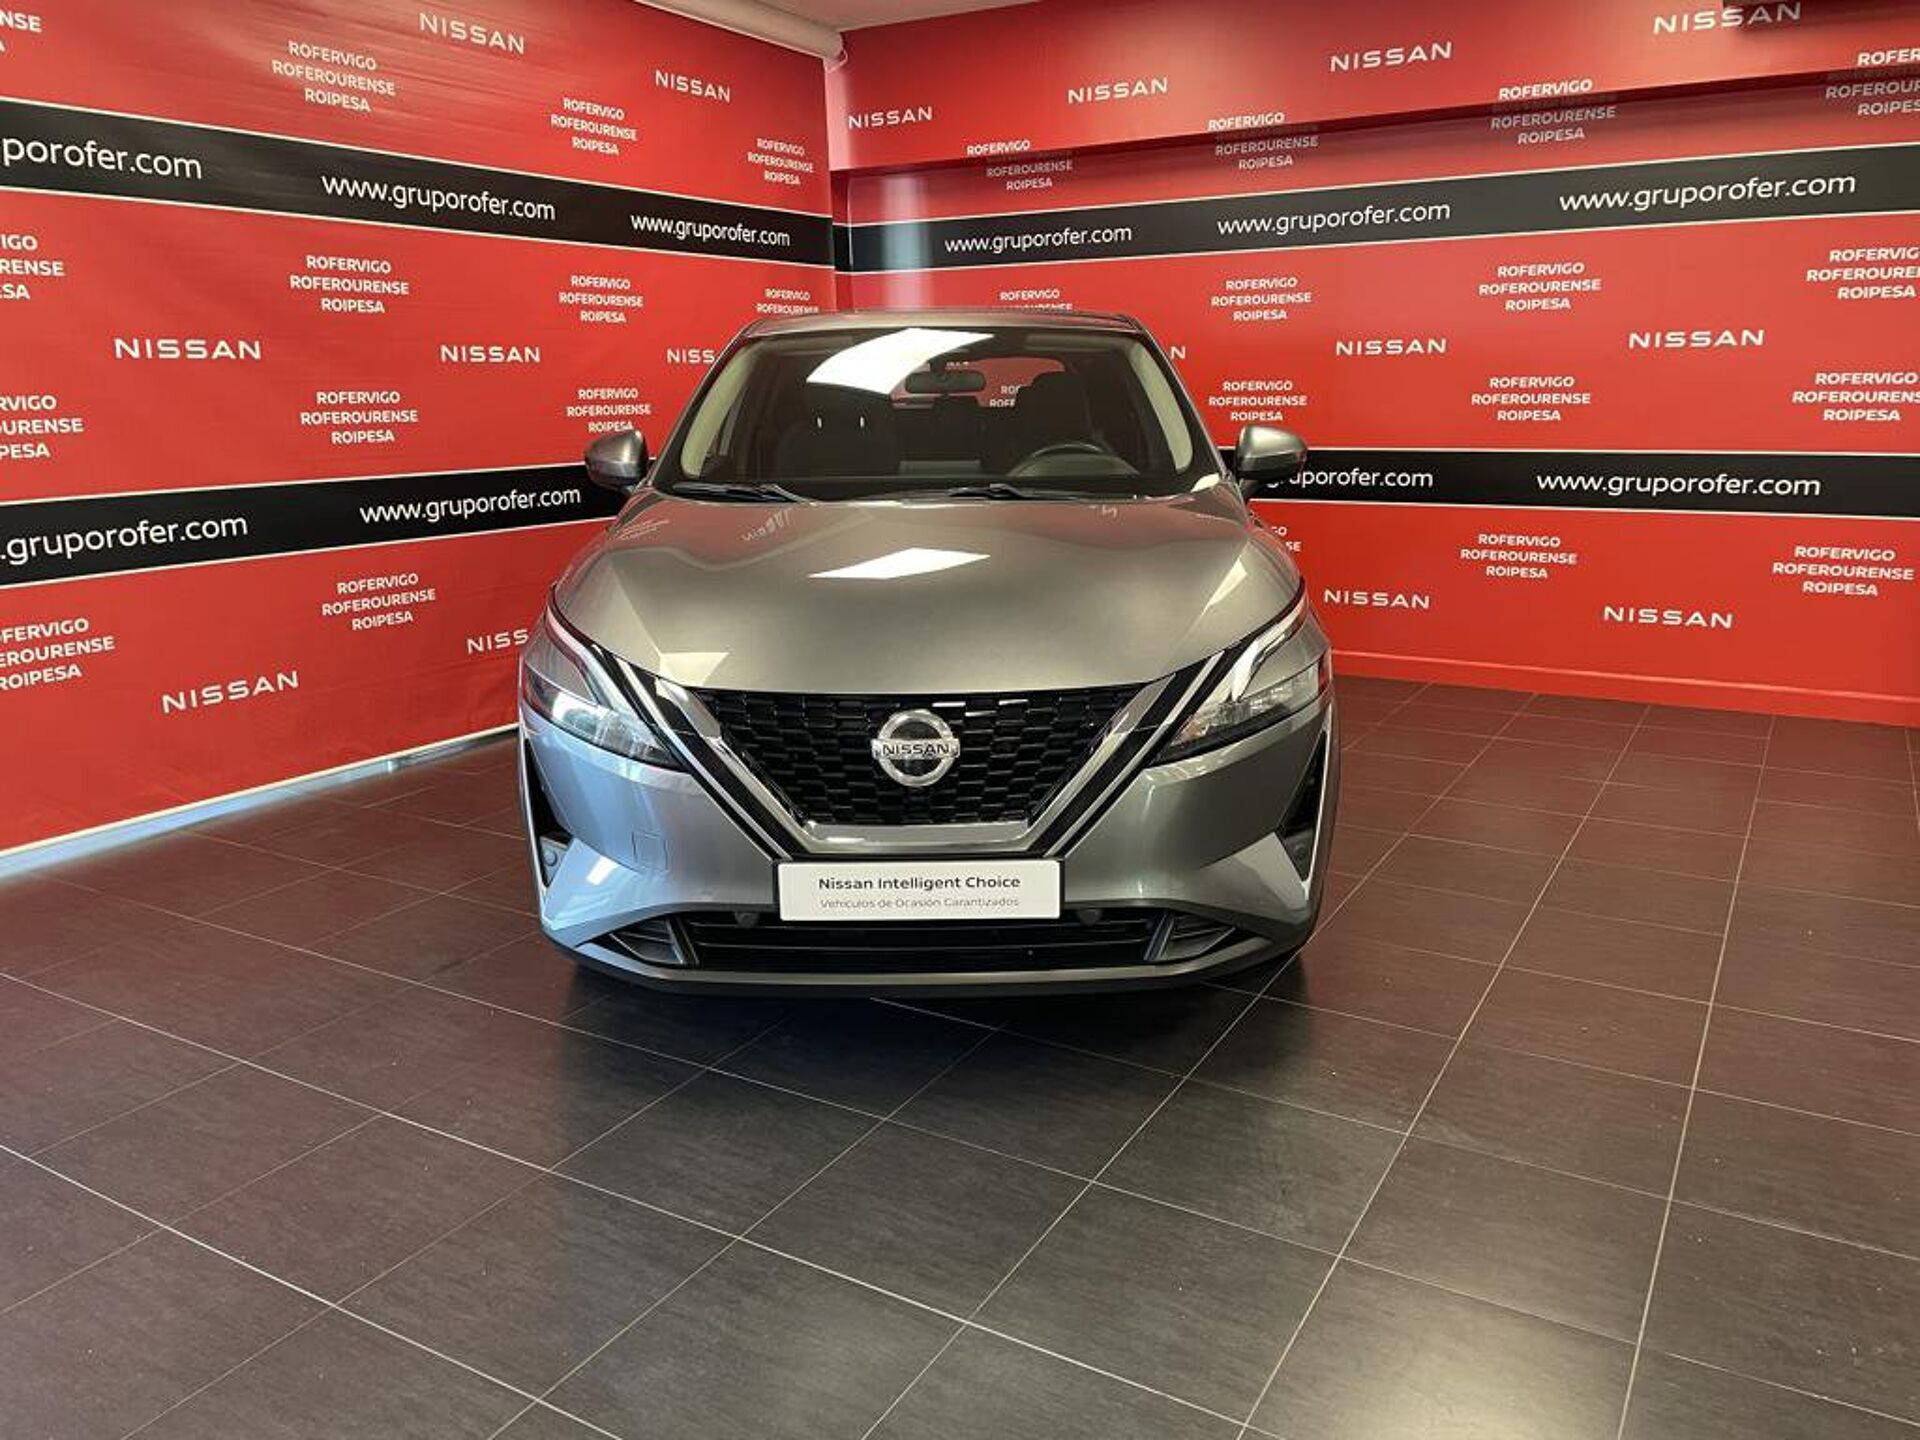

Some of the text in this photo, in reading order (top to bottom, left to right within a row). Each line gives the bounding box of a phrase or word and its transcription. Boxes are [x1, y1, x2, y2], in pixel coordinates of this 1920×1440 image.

[1652, 3, 1801, 34] NISSAN
[419, 12, 525, 55] NISSAN
[288, 40, 377, 71] ROFERVIGO
[1330, 41, 1453, 73] NISSAN
[271, 59, 397, 96] ROFEROURENSE
[655, 69, 731, 104] NISSAN
[1068, 77, 1168, 104] NISSAN
[1499, 78, 1593, 101] ROFERVIGO
[304, 87, 371, 113] ROIPESA
[562, 97, 625, 121] ROFERVIGO
[848, 106, 933, 129] NISSAN
[1207, 111, 1286, 132] ROFERVIGO
[1490, 106, 1617, 130] ROFEROURENSE
[550, 114, 638, 142] ROFEROURENSE
[1518, 127, 1586, 145] ROIPESA
[966, 140, 1031, 156] ROFERVIGO
[1215, 135, 1320, 157] ROFEROURENSE
[2, 137, 202, 180] porofer.com
[1238, 155, 1294, 171] ROIPESA
[1006, 177, 1053, 191] ROIPESA
[1559, 173, 1857, 212] www.gruporofer.com
[322, 175, 556, 222] www.gruporofer.com
[1217, 202, 1451, 237] www.gruporofer.com
[631, 214, 791, 247] www.gruporofer.com
[945, 225, 1133, 254] www.gruporofer.com
[306, 255, 392, 274] ROFERVIGO
[1497, 261, 1585, 279] ROFERVIGO
[290, 274, 409, 296] ROFEROURENSE
[570, 275, 632, 291] ROFERVIGO
[1225, 277, 1298, 292] ROFERVIGO
[1478, 278, 1602, 296] ROFEROURENSE
[1837, 284, 1917, 300] ROIPESA
[321, 297, 385, 314] ROIPESA
[558, 291, 644, 308] ROFEROURENSE
[1210, 292, 1312, 308] ROFEROURENSE
[1505, 297, 1572, 311] ROIPESA
[580, 309, 627, 325] ROIPESA
[1232, 309, 1288, 321] ROIPESA
[1335, 338, 1447, 356] NISSAN
[1628, 329, 1765, 349] NISSAN
[115, 339, 261, 360] NISSAN
[440, 345, 541, 363] NISSAN
[667, 348, 715, 364] NISS
[1222, 381, 1294, 392] ROFERVIGO
[1488, 376, 1575, 389] ROFERVIGO
[1814, 371, 1919, 385] ROFERVIGO
[316, 391, 401, 405] ROFERVIGO
[577, 387, 639, 401] ROFERVIGO
[1208, 396, 1308, 407] ROFEROURENSE
[1471, 393, 1592, 406] ROFEROURENSE
[300, 409, 419, 426] ROFEROURENSE
[566, 403, 652, 418] ROFEROURENSE
[1230, 410, 1284, 422] ROIPESA
[1497, 410, 1562, 422] ROIPESA
[1823, 408, 1902, 422] ROIPESA
[0, 417, 84, 436] URENSE
[331, 429, 395, 444] ROIPESA
[1537, 473, 1822, 497] www.gruporofer.com
[359, 486, 582, 525] www.gruporofer.com
[1478, 534, 1561, 548] ROFERVIGO
[1460, 549, 1578, 564] ROFEROURENSE
[1794, 546, 1896, 562] ROFERVIGO
[1486, 565, 1549, 579] ROIPESA
[1772, 562, 1915, 581] ROFEROURENSE
[337, 573, 419, 595] ROFERVIGO
[1802, 581, 1878, 597] ROIPESA
[322, 588, 437, 616] ROFEROURENSE
[1324, 589, 1430, 609] NISSAN
[352, 610, 414, 632] ROIPESA
[1604, 606, 1734, 629] NISSAN
[0, 617, 90, 645] FERVIGO
[161, 671, 299, 714] NISSAN
[882, 743, 950, 756] NISSAN
[818, 875, 1021, 892] Nissan Intelligent Choice
[880, 898, 893, 908] de
